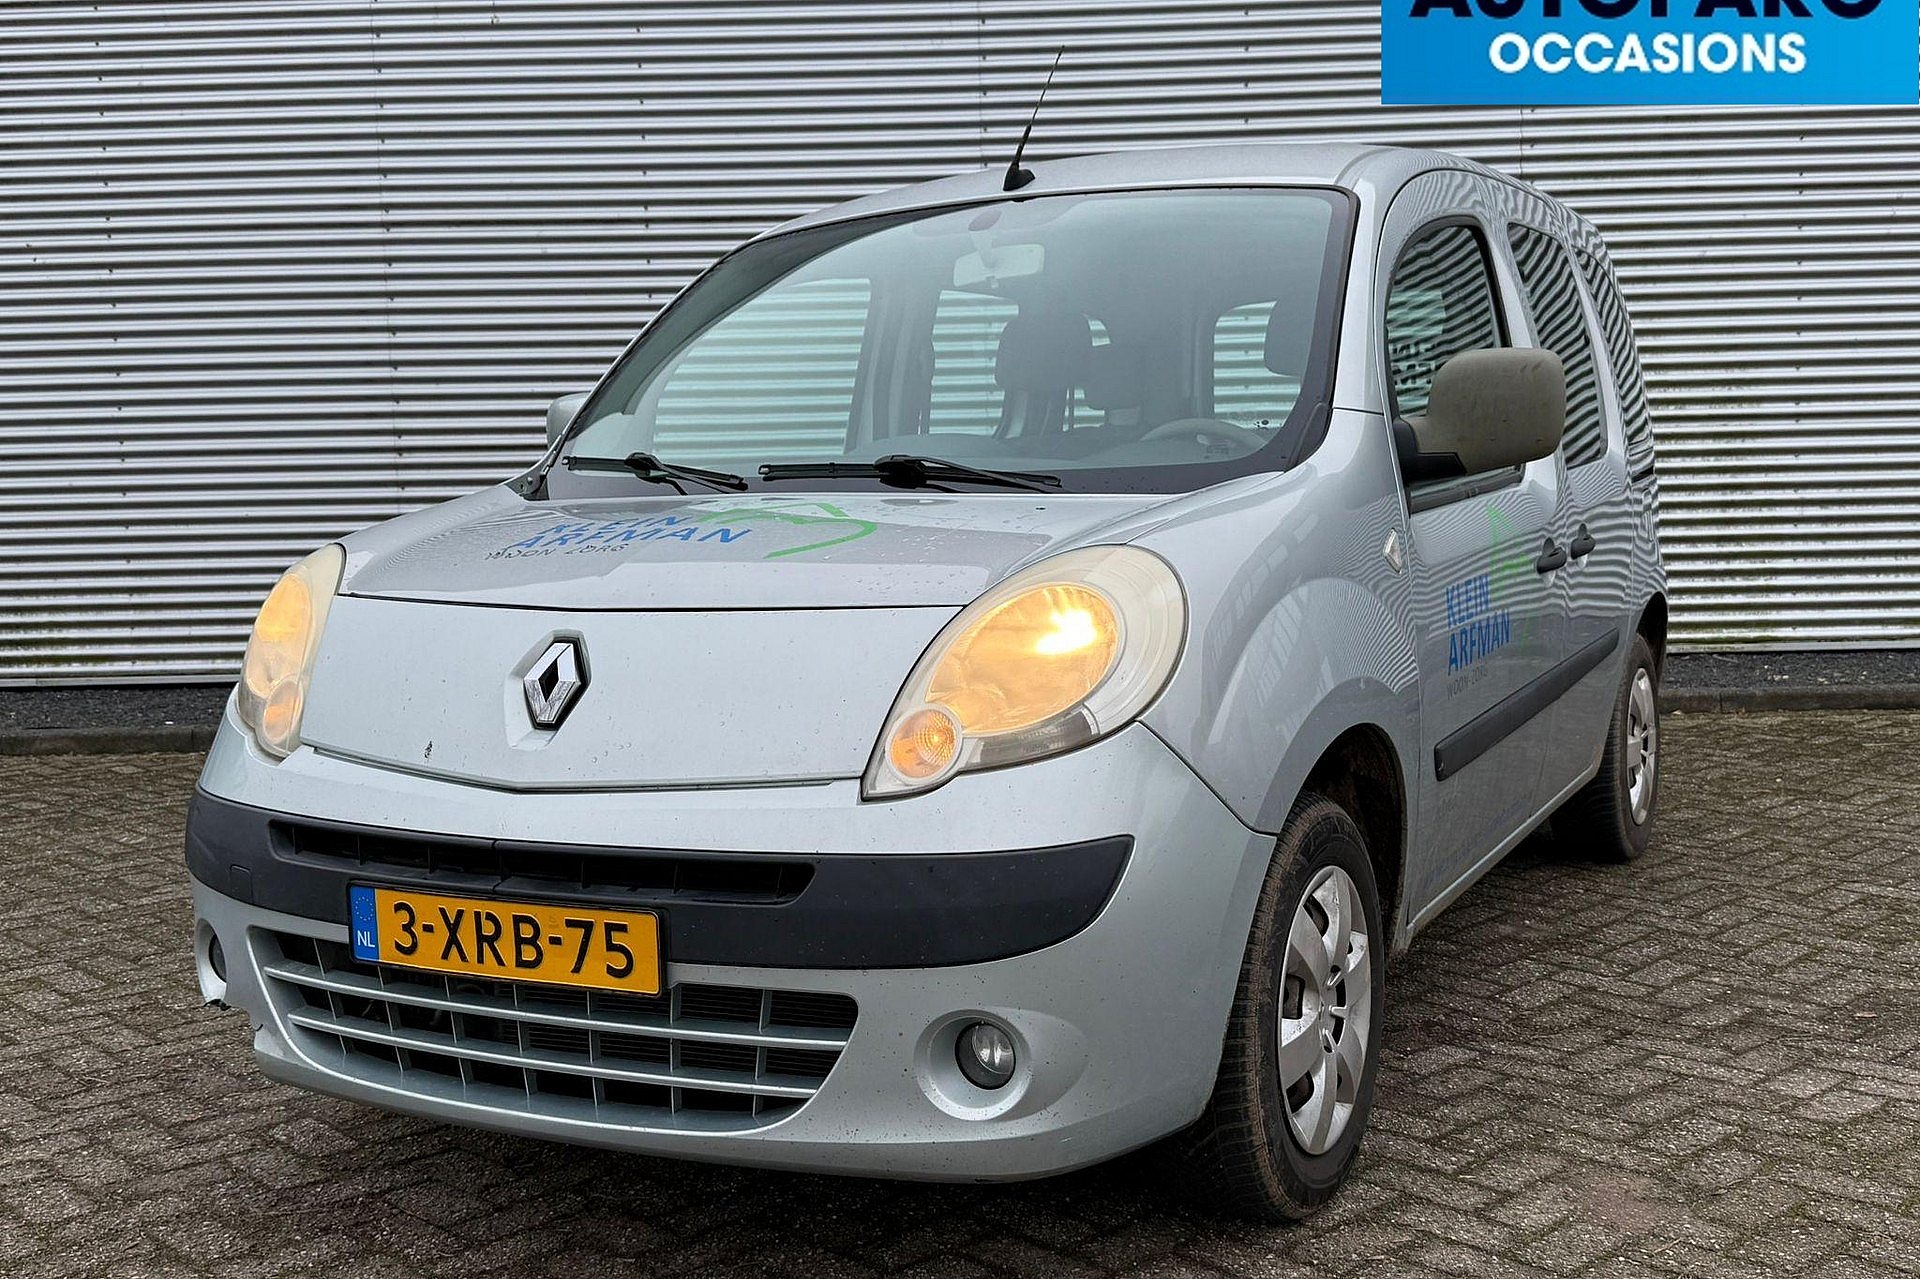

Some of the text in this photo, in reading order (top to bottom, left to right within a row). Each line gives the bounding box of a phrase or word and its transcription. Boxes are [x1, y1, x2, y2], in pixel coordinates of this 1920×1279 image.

[507, 526, 752, 549] ARFMAN
[537, 515, 693, 535] KLEIN
[1446, 573, 1490, 628] KLEIN
[1448, 609, 1510, 676] ARFMAN
[357, 930, 376, 948] NL
[393, 900, 635, 979] 3-XRB-75
